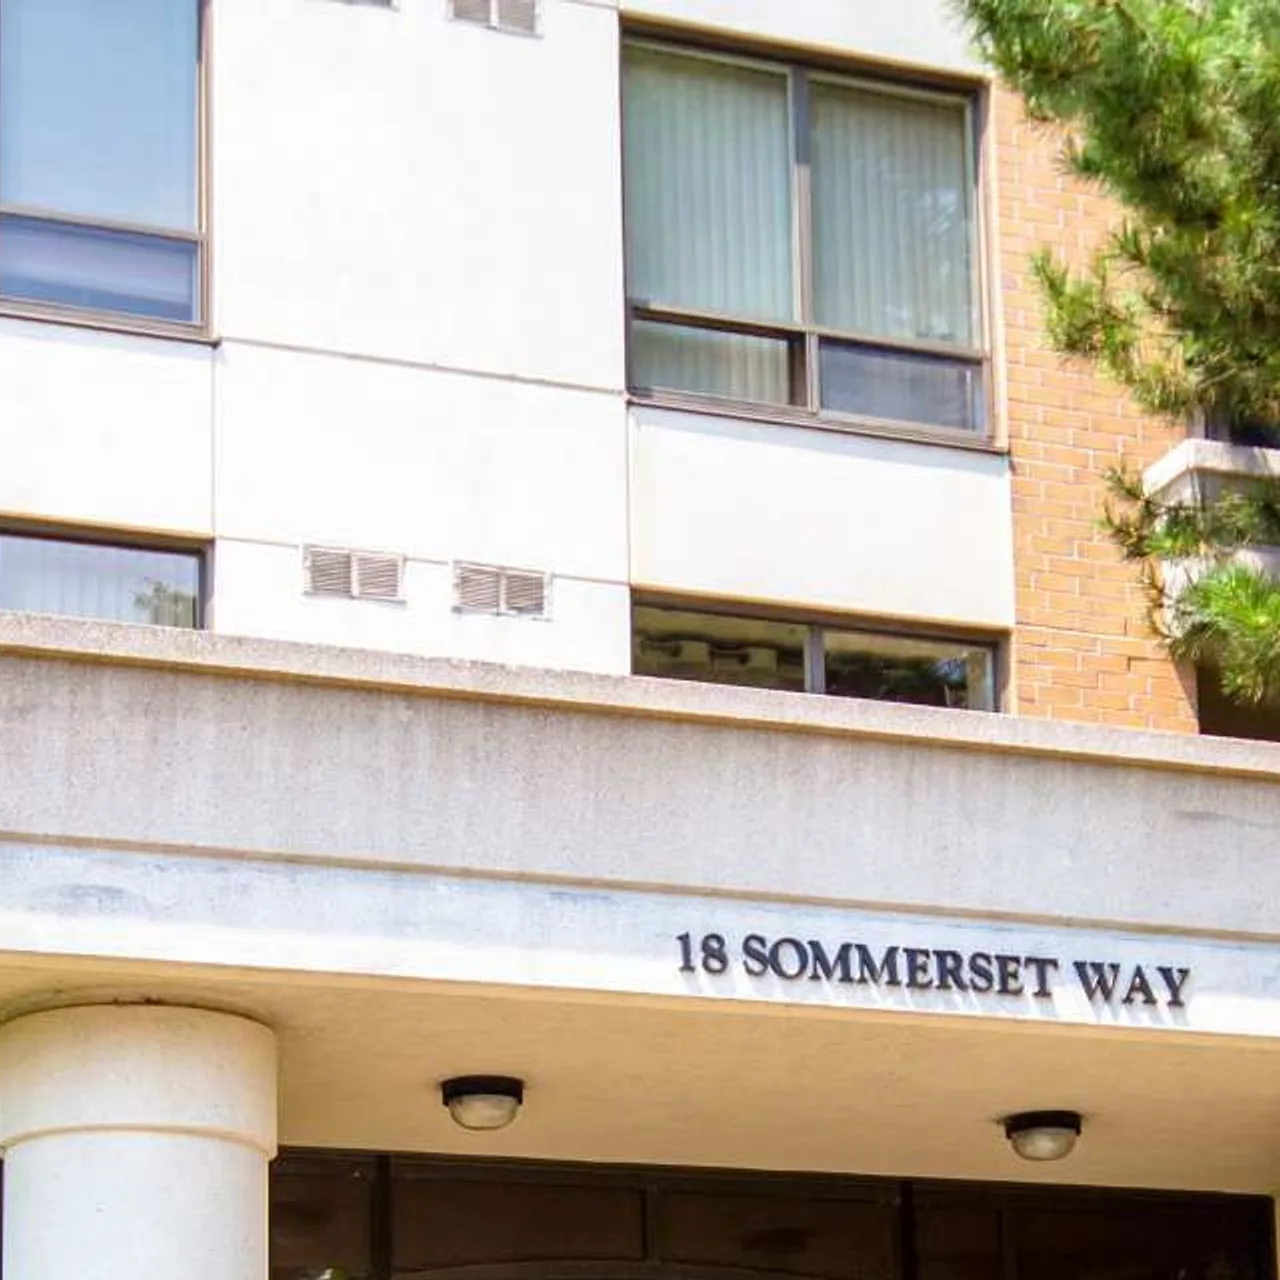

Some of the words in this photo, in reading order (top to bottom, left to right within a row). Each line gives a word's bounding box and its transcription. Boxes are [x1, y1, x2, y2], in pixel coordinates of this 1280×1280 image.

[675, 931, 728, 974] 18
[741, 933, 1059, 999] SOMMERSET
[1073, 959, 1191, 1007] WAY
